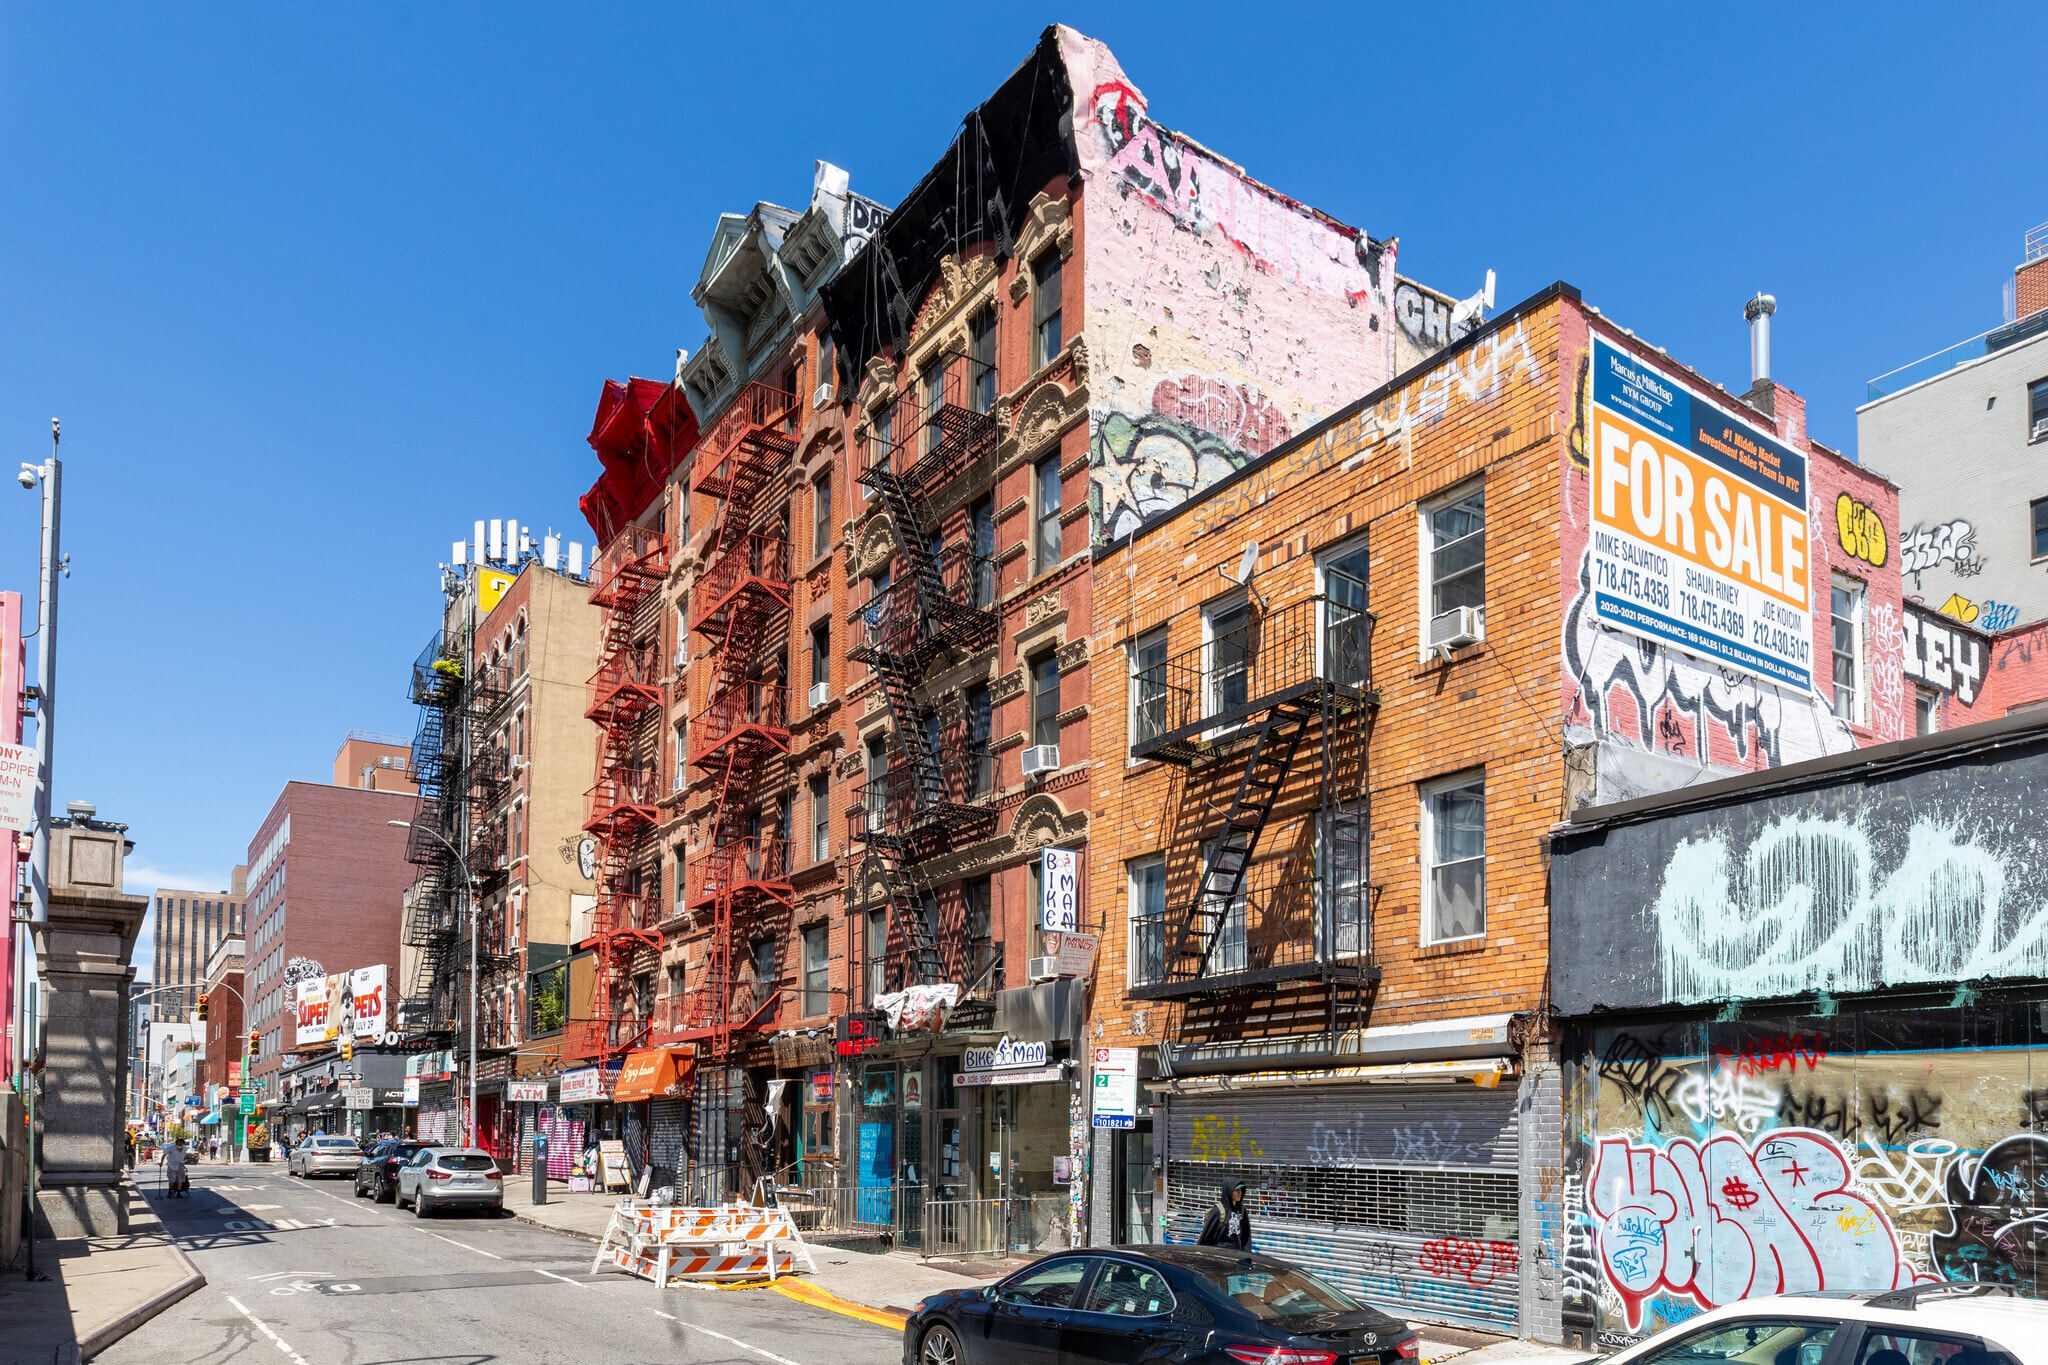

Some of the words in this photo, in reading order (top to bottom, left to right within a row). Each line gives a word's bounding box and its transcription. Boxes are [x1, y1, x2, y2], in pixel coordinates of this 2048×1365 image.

[1610, 356, 1636, 374] Marcus
[1635, 375, 1642, 389] &
[1641, 374, 1673, 405] Millichap
[1622, 384, 1639, 401] NYM
[1639, 394, 1662, 413] GROUP
[1699, 428, 1738, 460] Investment
[1739, 451, 1757, 470] Sales
[1758, 461, 1777, 481] Team
[1778, 472, 1785, 486] in
[1786, 476, 1800, 493] NYC
[1723, 428, 1732, 442] #1
[1734, 433, 1757, 456] Middle
[1758, 446, 1781, 468] Market
[1600, 421, 1696, 555] FOR
[1704, 477, 1805, 603] SALE
[1595, 531, 1619, 558] MIKE
[1622, 541, 1668, 577] SALVATICO
[1596, 558, 1669, 610] 718.475.4358
[1686, 567, 1714, 596] SHAUN
[1716, 580, 1739, 606] RINEY
[1680, 590, 1744, 639] 718.475.4369
[1762, 600, 1775, 621] JOE
[1600, 600, 1636, 621] 2020-2021
[1637, 613, 1687, 639] PERFORMANCE:
[1688, 631, 1698, 643] 169
[1699, 635, 1717, 650] SALES
[1721, 643, 1733, 656] $1.2
[1733, 648, 1757, 665] BILLION
[1757, 657, 1764, 667] IN
[1764, 660, 1786, 676] DOLLAR
[1786, 668, 1808, 685] VOLUME
[1753, 620, 1809, 665] 212.430.5147
[1046, 852, 1057, 927] BIKE
[1060, 874, 1074, 930] MAN
[298, 1000, 328, 1028] SUPER
[354, 985, 382, 1019] PETS
[367, 1020, 374, 1029] 29
[372, 1031, 399, 1046] 90
[966, 1050, 994, 1067] BIKE
[1013, 1045, 1044, 1063] MAN
[515, 1089, 543, 1100] ATM
[980, 1072, 994, 1083] repair
[997, 1071, 1029, 1082] accessories
[1098, 1075, 1106, 1087] 2
[539, 1140, 545, 1148] P
[861, 1140, 876, 1150] SPACE
[861, 1151, 870, 1161] FOR
[224, 1218, 341, 1231] ONLY
